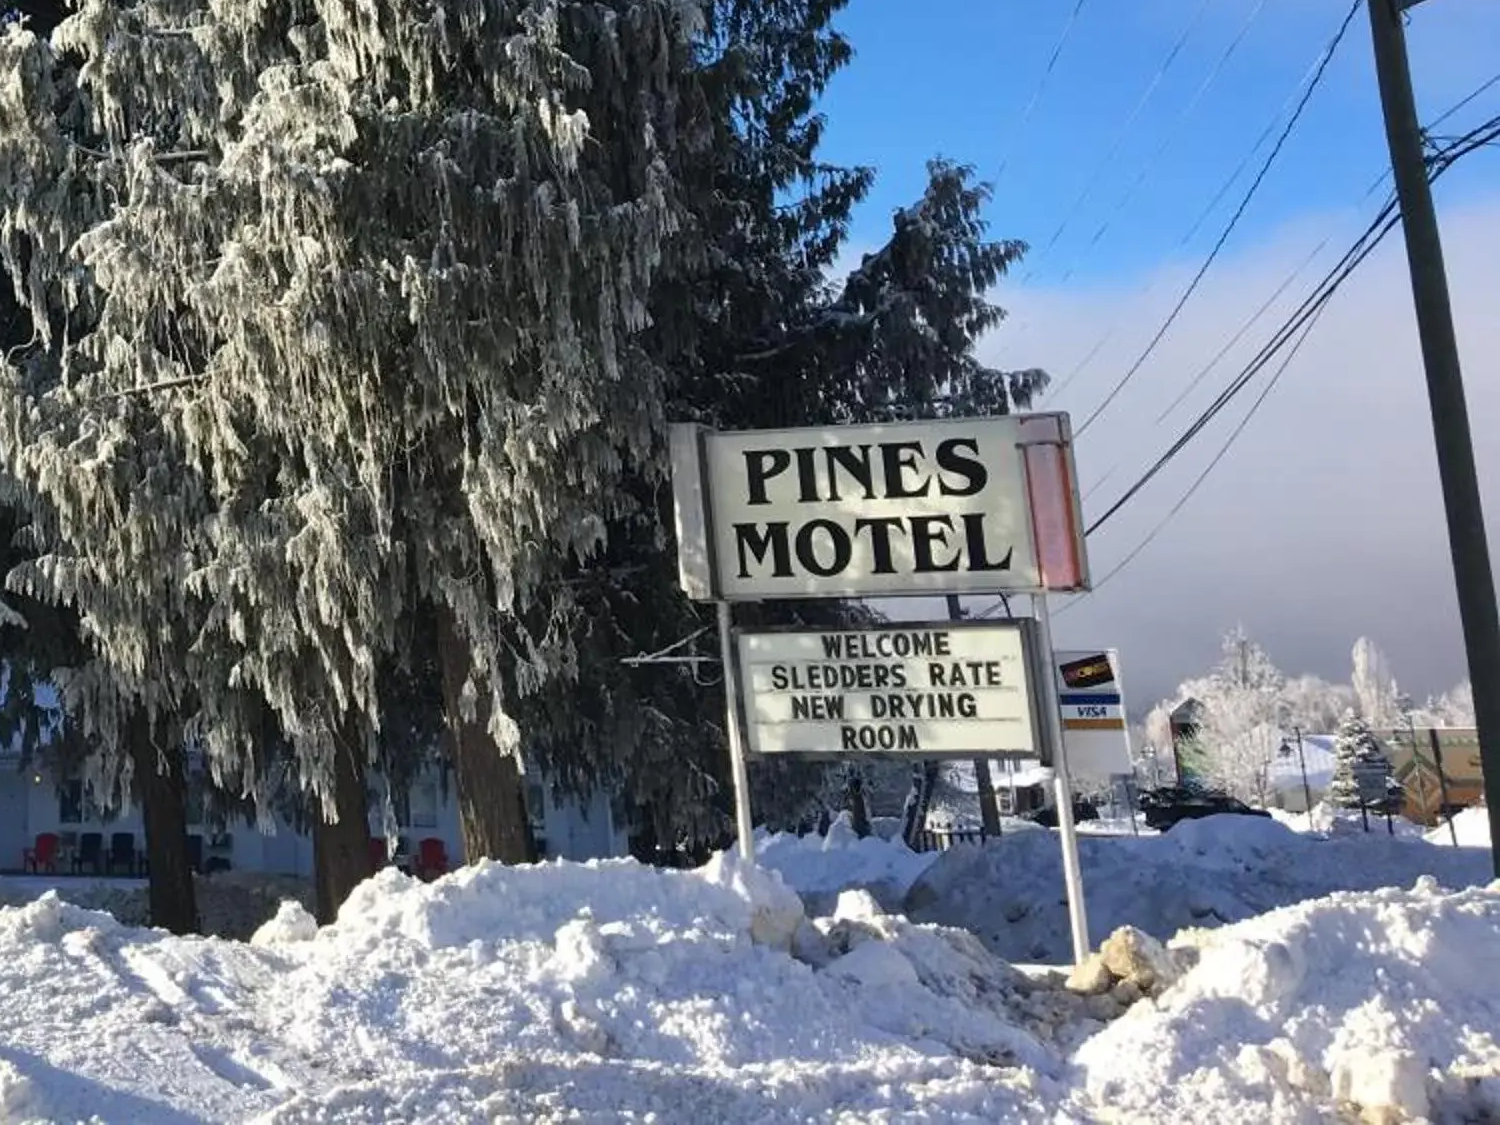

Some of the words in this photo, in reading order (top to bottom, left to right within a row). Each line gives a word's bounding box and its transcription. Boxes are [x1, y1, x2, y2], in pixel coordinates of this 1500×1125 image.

[742, 438, 988, 505] PINES
[733, 513, 1013, 579] MOTEL
[822, 632, 951, 659] WELCOME
[772, 662, 906, 690] SLEDDERS
[930, 660, 1002, 687] RATE
[791, 694, 845, 719] NEW
[871, 692, 977, 718] DRYING
[1077, 706, 1107, 717] VISA
[841, 724, 920, 751] ROOM
